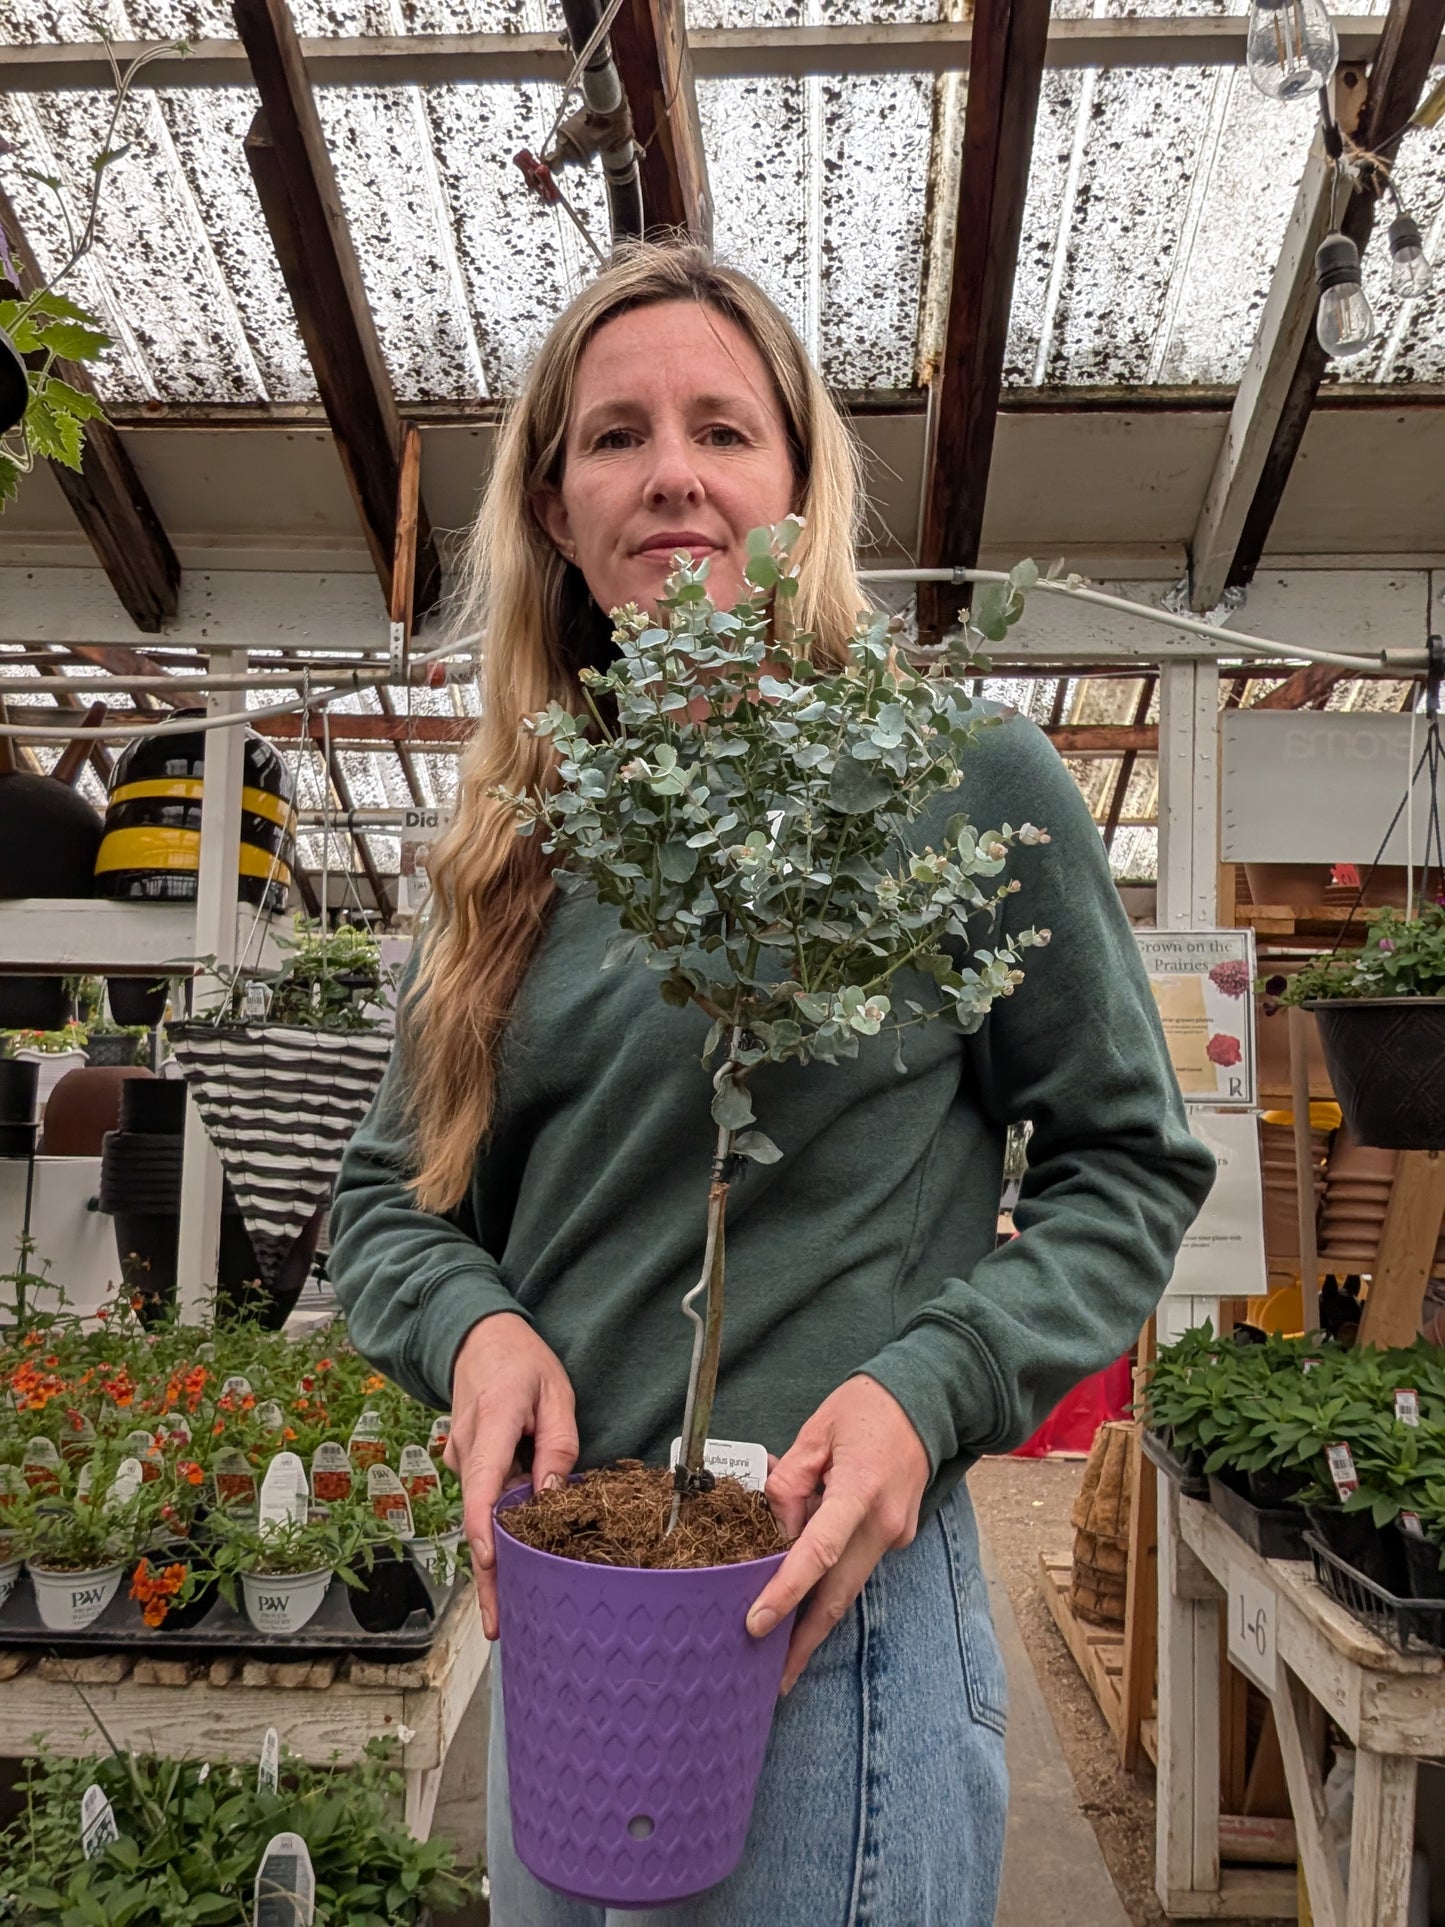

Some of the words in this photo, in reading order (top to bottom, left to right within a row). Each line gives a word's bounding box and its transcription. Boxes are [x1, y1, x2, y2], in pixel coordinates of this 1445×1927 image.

[1186, 942, 1205, 953] on
[1209, 940, 1233, 953] the
[1154, 958, 1209, 971] Prairies
[1240, 1594, 1267, 1656] 1-6
